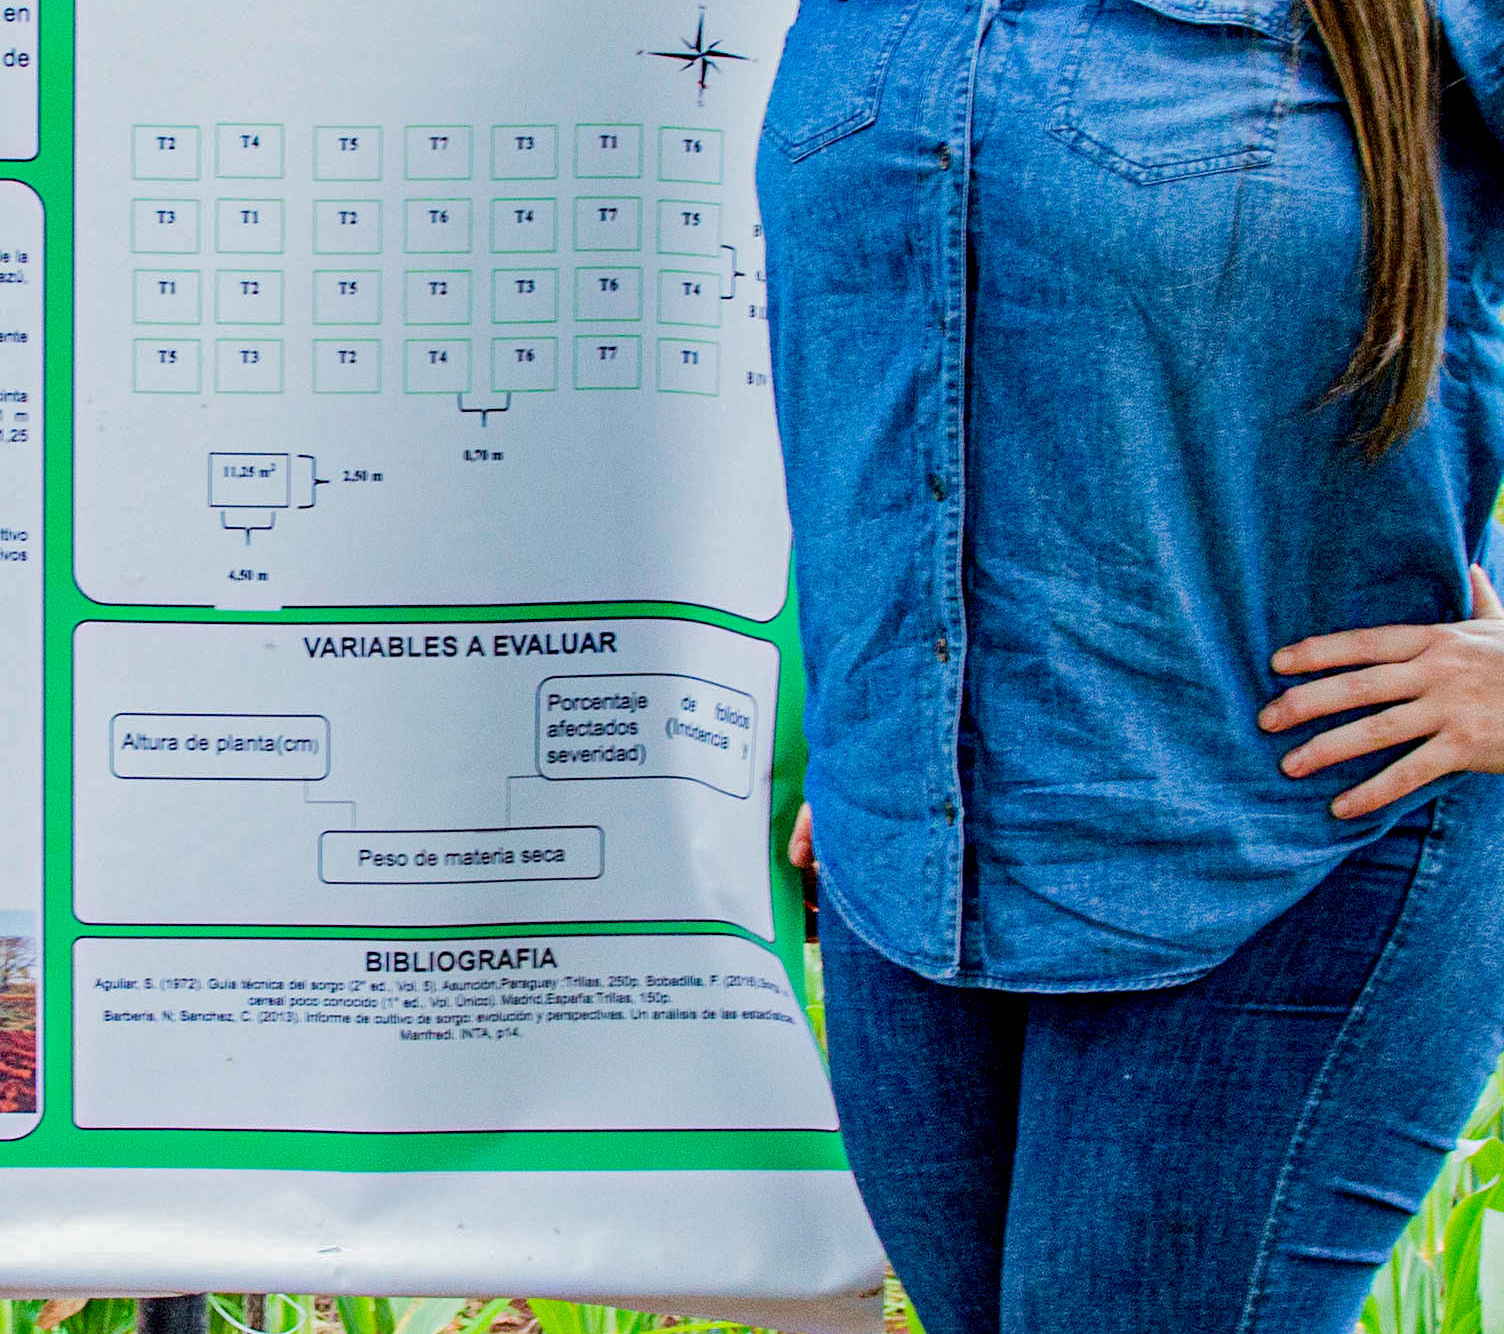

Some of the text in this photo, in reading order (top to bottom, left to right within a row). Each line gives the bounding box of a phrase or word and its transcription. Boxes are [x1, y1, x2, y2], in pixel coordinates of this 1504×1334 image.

[3, 7, 30, 22] en
[2, 48, 30, 67] de
[303, 632, 618, 658] VARIABLES A EVALUAR
[547, 692, 648, 714] Porcentaje
[546, 719, 639, 738] afectados
[121, 733, 319, 755] Altura de planta(cm)
[546, 744, 647, 766] severidad)
[358, 847, 566, 867] Peso de materia seca
[364, 947, 559, 973] BIBLIOGRAFIA
